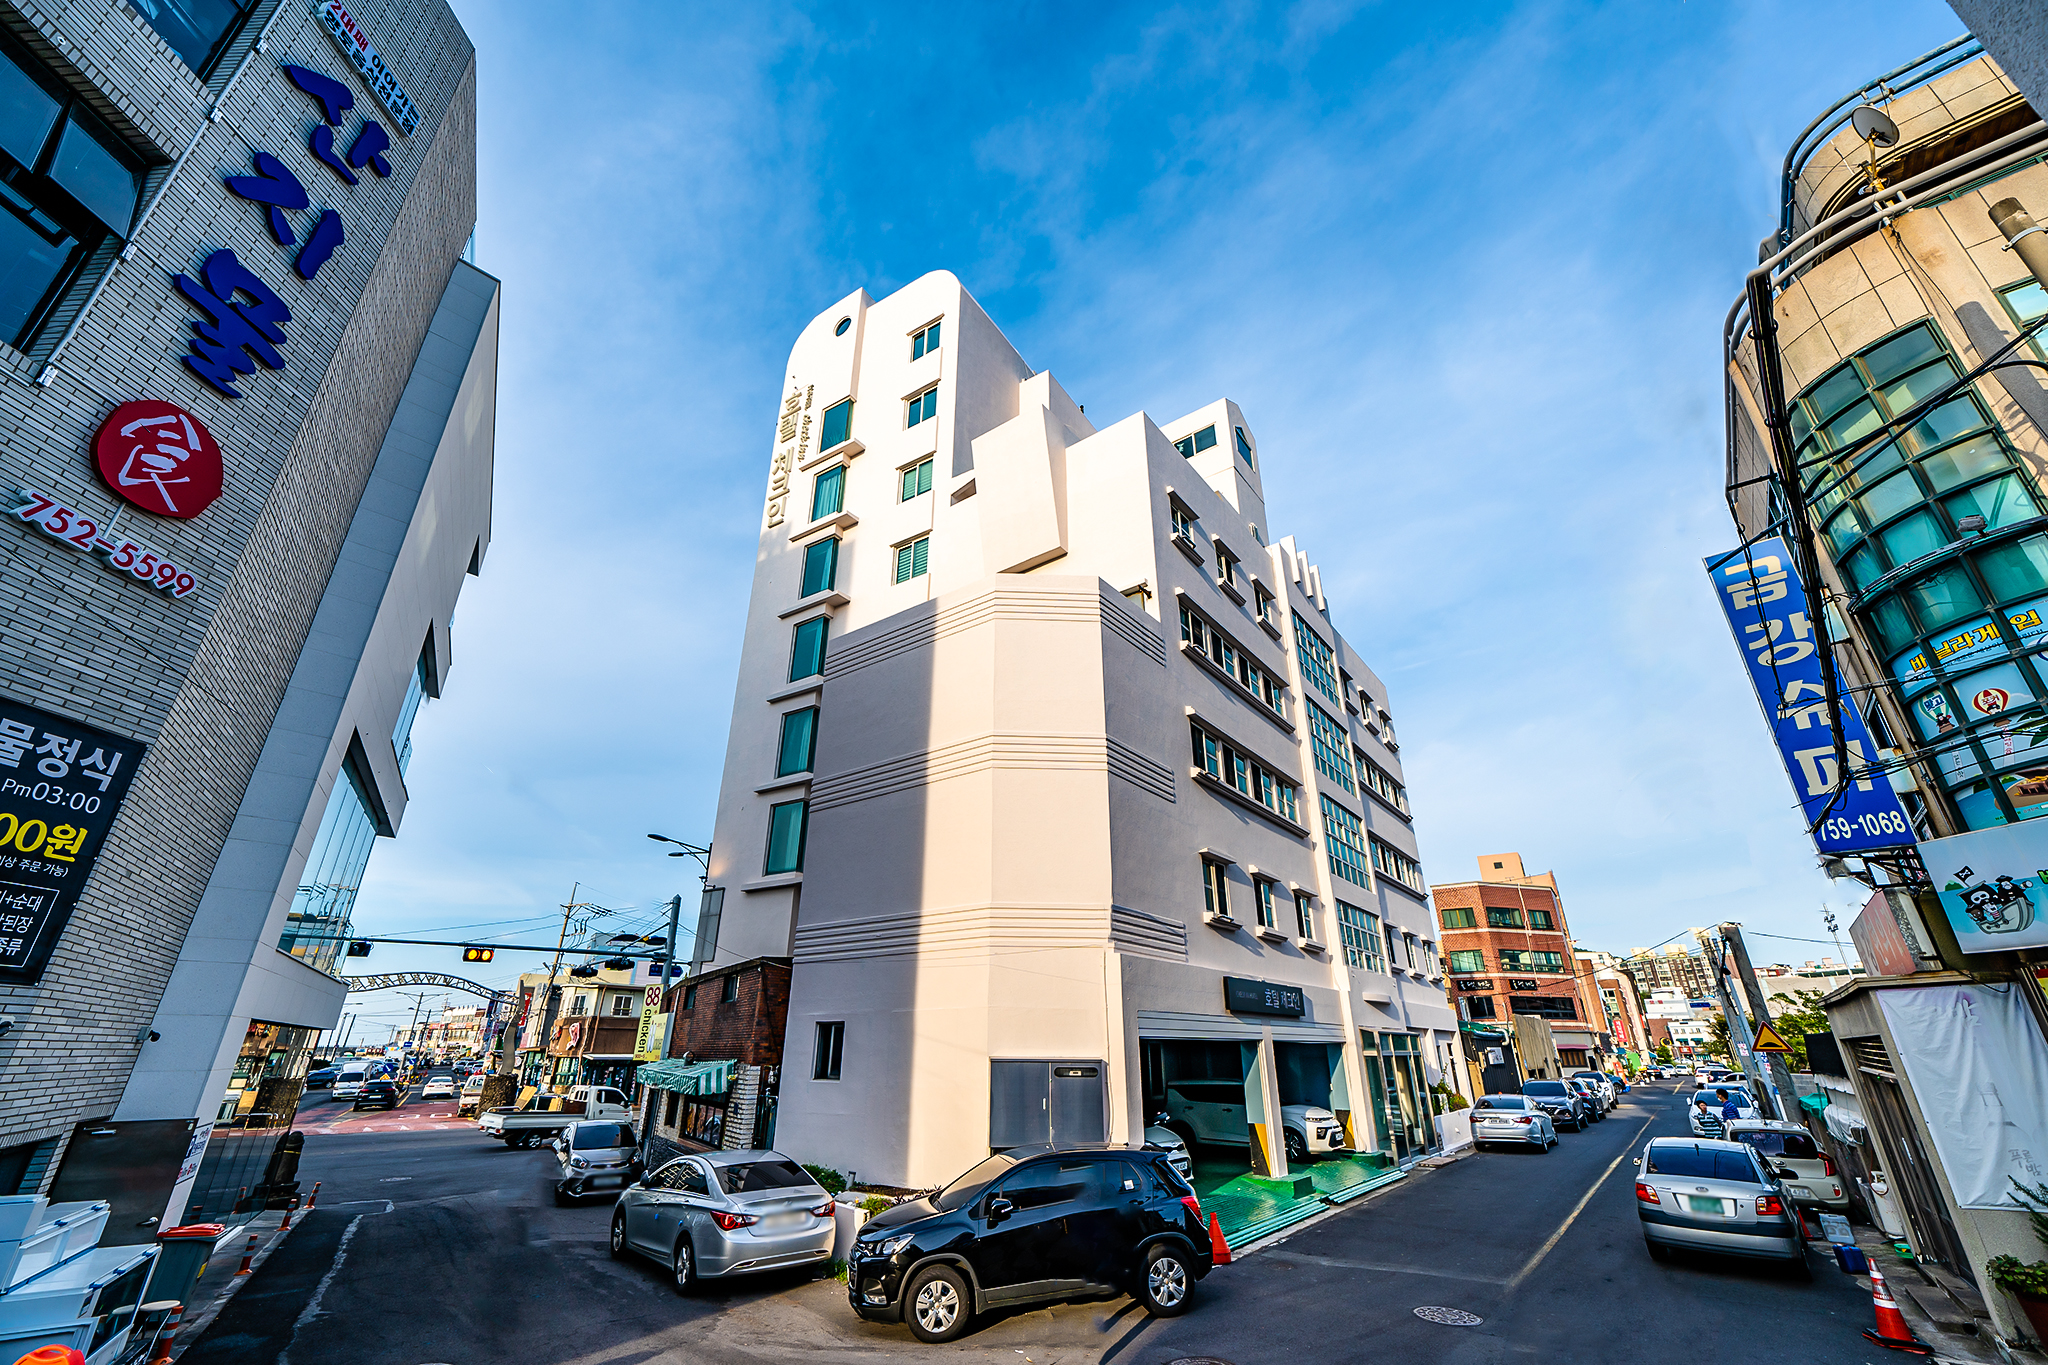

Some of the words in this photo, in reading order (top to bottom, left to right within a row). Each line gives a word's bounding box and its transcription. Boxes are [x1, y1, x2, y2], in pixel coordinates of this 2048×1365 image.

[323, 9, 416, 136] 향토음식전문점
[371, 54, 420, 125] 이어가는
[780, 391, 802, 443] 호텔
[766, 446, 795, 528] 체크인
[21, 492, 196, 596] 752-5599
[1, 778, 101, 814] Pm03:00
[19, 858, 42, 873] 주문
[645, 986, 661, 1006] 88
[637, 1008, 652, 1053] chicken
